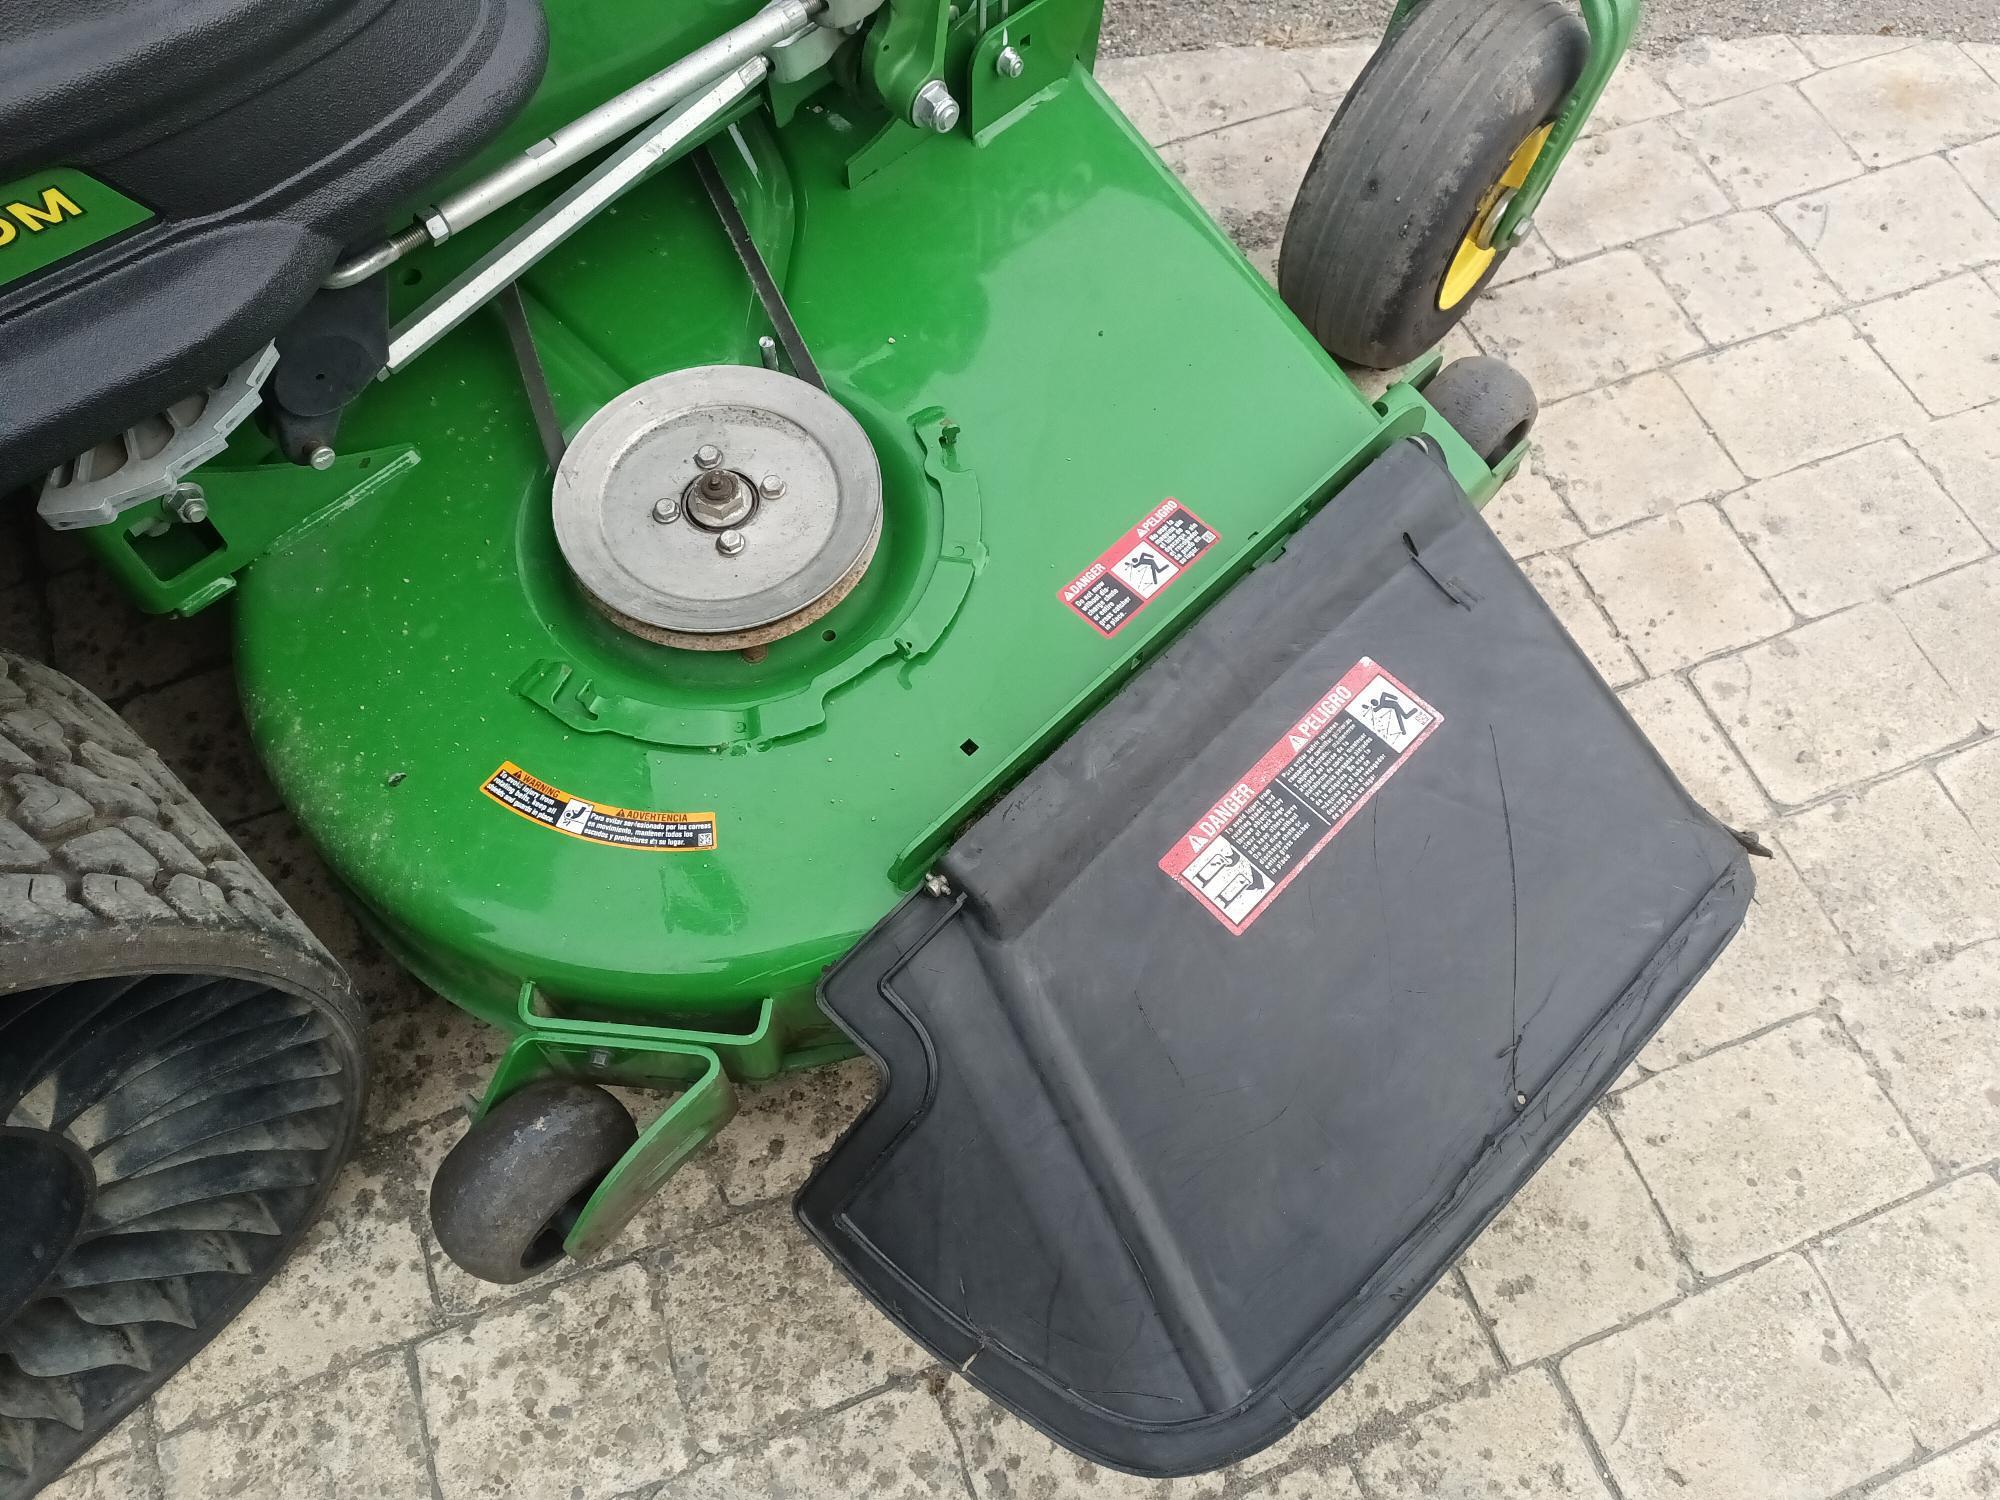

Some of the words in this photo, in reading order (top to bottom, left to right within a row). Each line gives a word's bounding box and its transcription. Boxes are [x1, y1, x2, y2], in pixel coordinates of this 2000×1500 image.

[1142, 500, 1177, 531] PELIGRO
[1070, 564, 1106, 594] DANGER
[1075, 599, 1085, 607] Do
[1083, 591, 1094, 600] not
[1092, 581, 1105, 593] mow
[1082, 594, 1101, 611] without
[1099, 587, 1109, 596] dis-
[1088, 600, 1105, 616] charge
[1104, 589, 1119, 601] chute
[1099, 602, 1115, 615] entire
[1099, 612, 1114, 626] grass
[1112, 596, 1131, 613] catcher
[1110, 612, 1127, 626] place.
[1298, 686, 1352, 737] PELIGRO
[1281, 767, 1294, 778] Para
[1294, 753, 1307, 767] evitar
[1307, 740, 1320, 754] sufrir
[1318, 722, 1339, 741] lesiones
[492, 777, 515, 794] rotating
[514, 790, 530, 804] belts,
[532, 799, 547, 811] keep
[500, 771, 507, 779] To
[506, 777, 524, 789] avoid
[522, 785, 540, 799] injury
[540, 794, 554, 805] from
[523, 774, 560, 798] WARNING
[487, 783, 505, 797] shields
[504, 795, 516, 803] and
[513, 800, 532, 813] guards
[536, 812, 553, 823] place.
[627, 811, 687, 823] ADVERTENCIA
[1199, 784, 1255, 837] DANGER
[1231, 820, 1252, 839] rotating
[1249, 805, 1266, 821] blades
[1266, 794, 1275, 805] and
[1233, 813, 1247, 828] avoid
[1245, 800, 1261, 814] injury
[1259, 789, 1271, 800] from
[584, 828, 609, 838] escudos
[614, 835, 648, 844] protectores
[590, 813, 605, 821] Para
[634, 821, 664, 830] lesionado
[688, 822, 711, 830] correas
[594, 823, 633, 835] movimiento,
[1236, 828, 1254, 845] thrown
[1272, 798, 1283, 809] stay
[1243, 836, 1256, 849] clear
[1261, 819, 1273, 831] deck
[1272, 807, 1284, 819] edge
[1248, 844, 1259, 854] and
[1256, 833, 1270, 845] keep
[1269, 817, 1285, 833] others
[1261, 842, 1270, 852] not
[1269, 831, 1281, 843] mow
[1280, 813, 1298, 831] without
[1259, 841, 1283, 864] discharge
[1282, 827, 1296, 841] chute
[1265, 854, 1280, 869] entire
[1279, 840, 1293, 855] grass
[1292, 822, 1310, 841] catcher
[1276, 854, 1290, 869] place.
